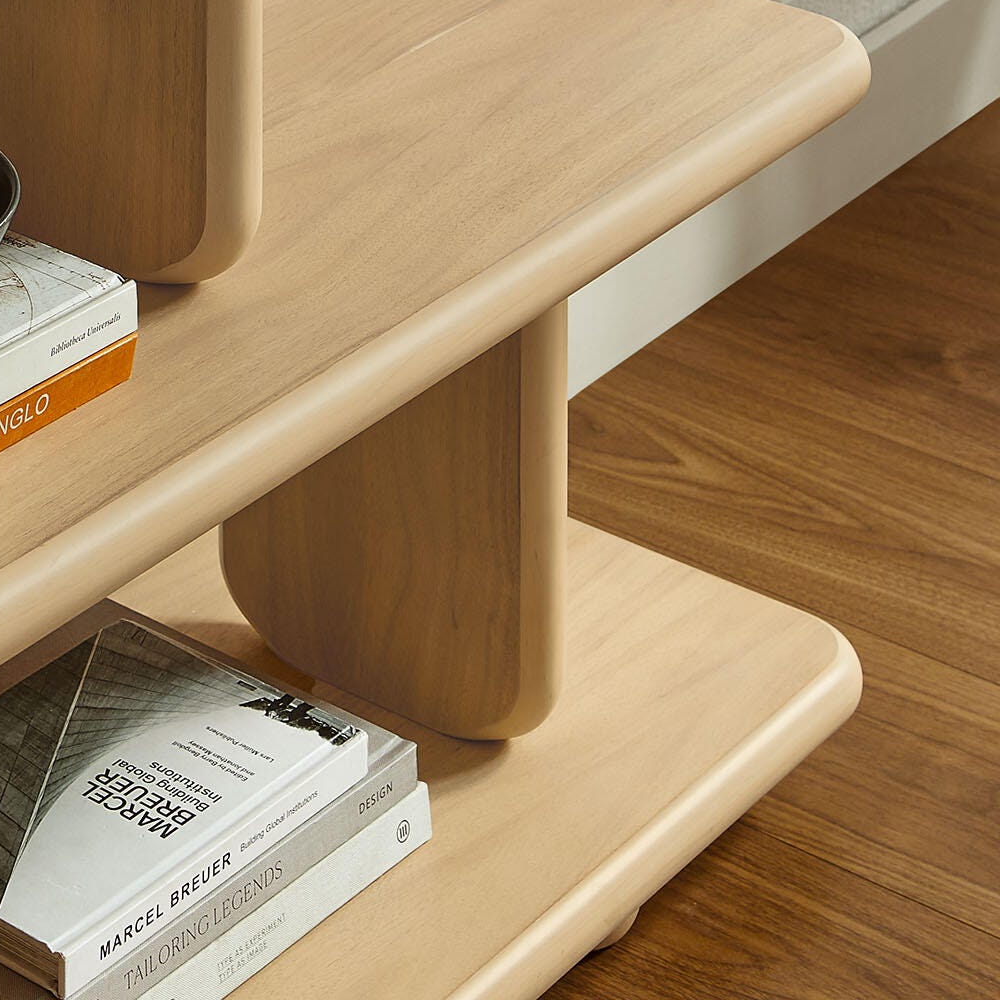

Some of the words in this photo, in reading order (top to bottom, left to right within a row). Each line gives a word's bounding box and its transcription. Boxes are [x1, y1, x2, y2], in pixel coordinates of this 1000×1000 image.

[50, 332, 86, 357] Bibliotheca
[87, 312, 121, 337] Universalis
[189, 740, 212, 755] Massey
[206, 726, 239, 746] Publishers
[111, 758, 156, 784] Global
[200, 754, 218, 766] Barry
[212, 753, 242, 769] Jonathan
[240, 767, 255, 777] and
[260, 753, 275, 763] Lars
[149, 761, 223, 804] Institutions
[225, 768, 248, 782] Edited
[81, 780, 179, 839] MARCEL
[95, 768, 197, 826] BREUER
[156, 778, 210, 813] Building
[359, 781, 393, 815] DESIGN
[99, 904, 164, 961] MARCEL
[170, 852, 232, 908] BREUER
[240, 829, 265, 852] Building
[265, 813, 286, 833] Global
[286, 790, 318, 819] Institutions
[123, 913, 210, 990] TAILORING
[213, 860, 283, 925] LEGENDS
